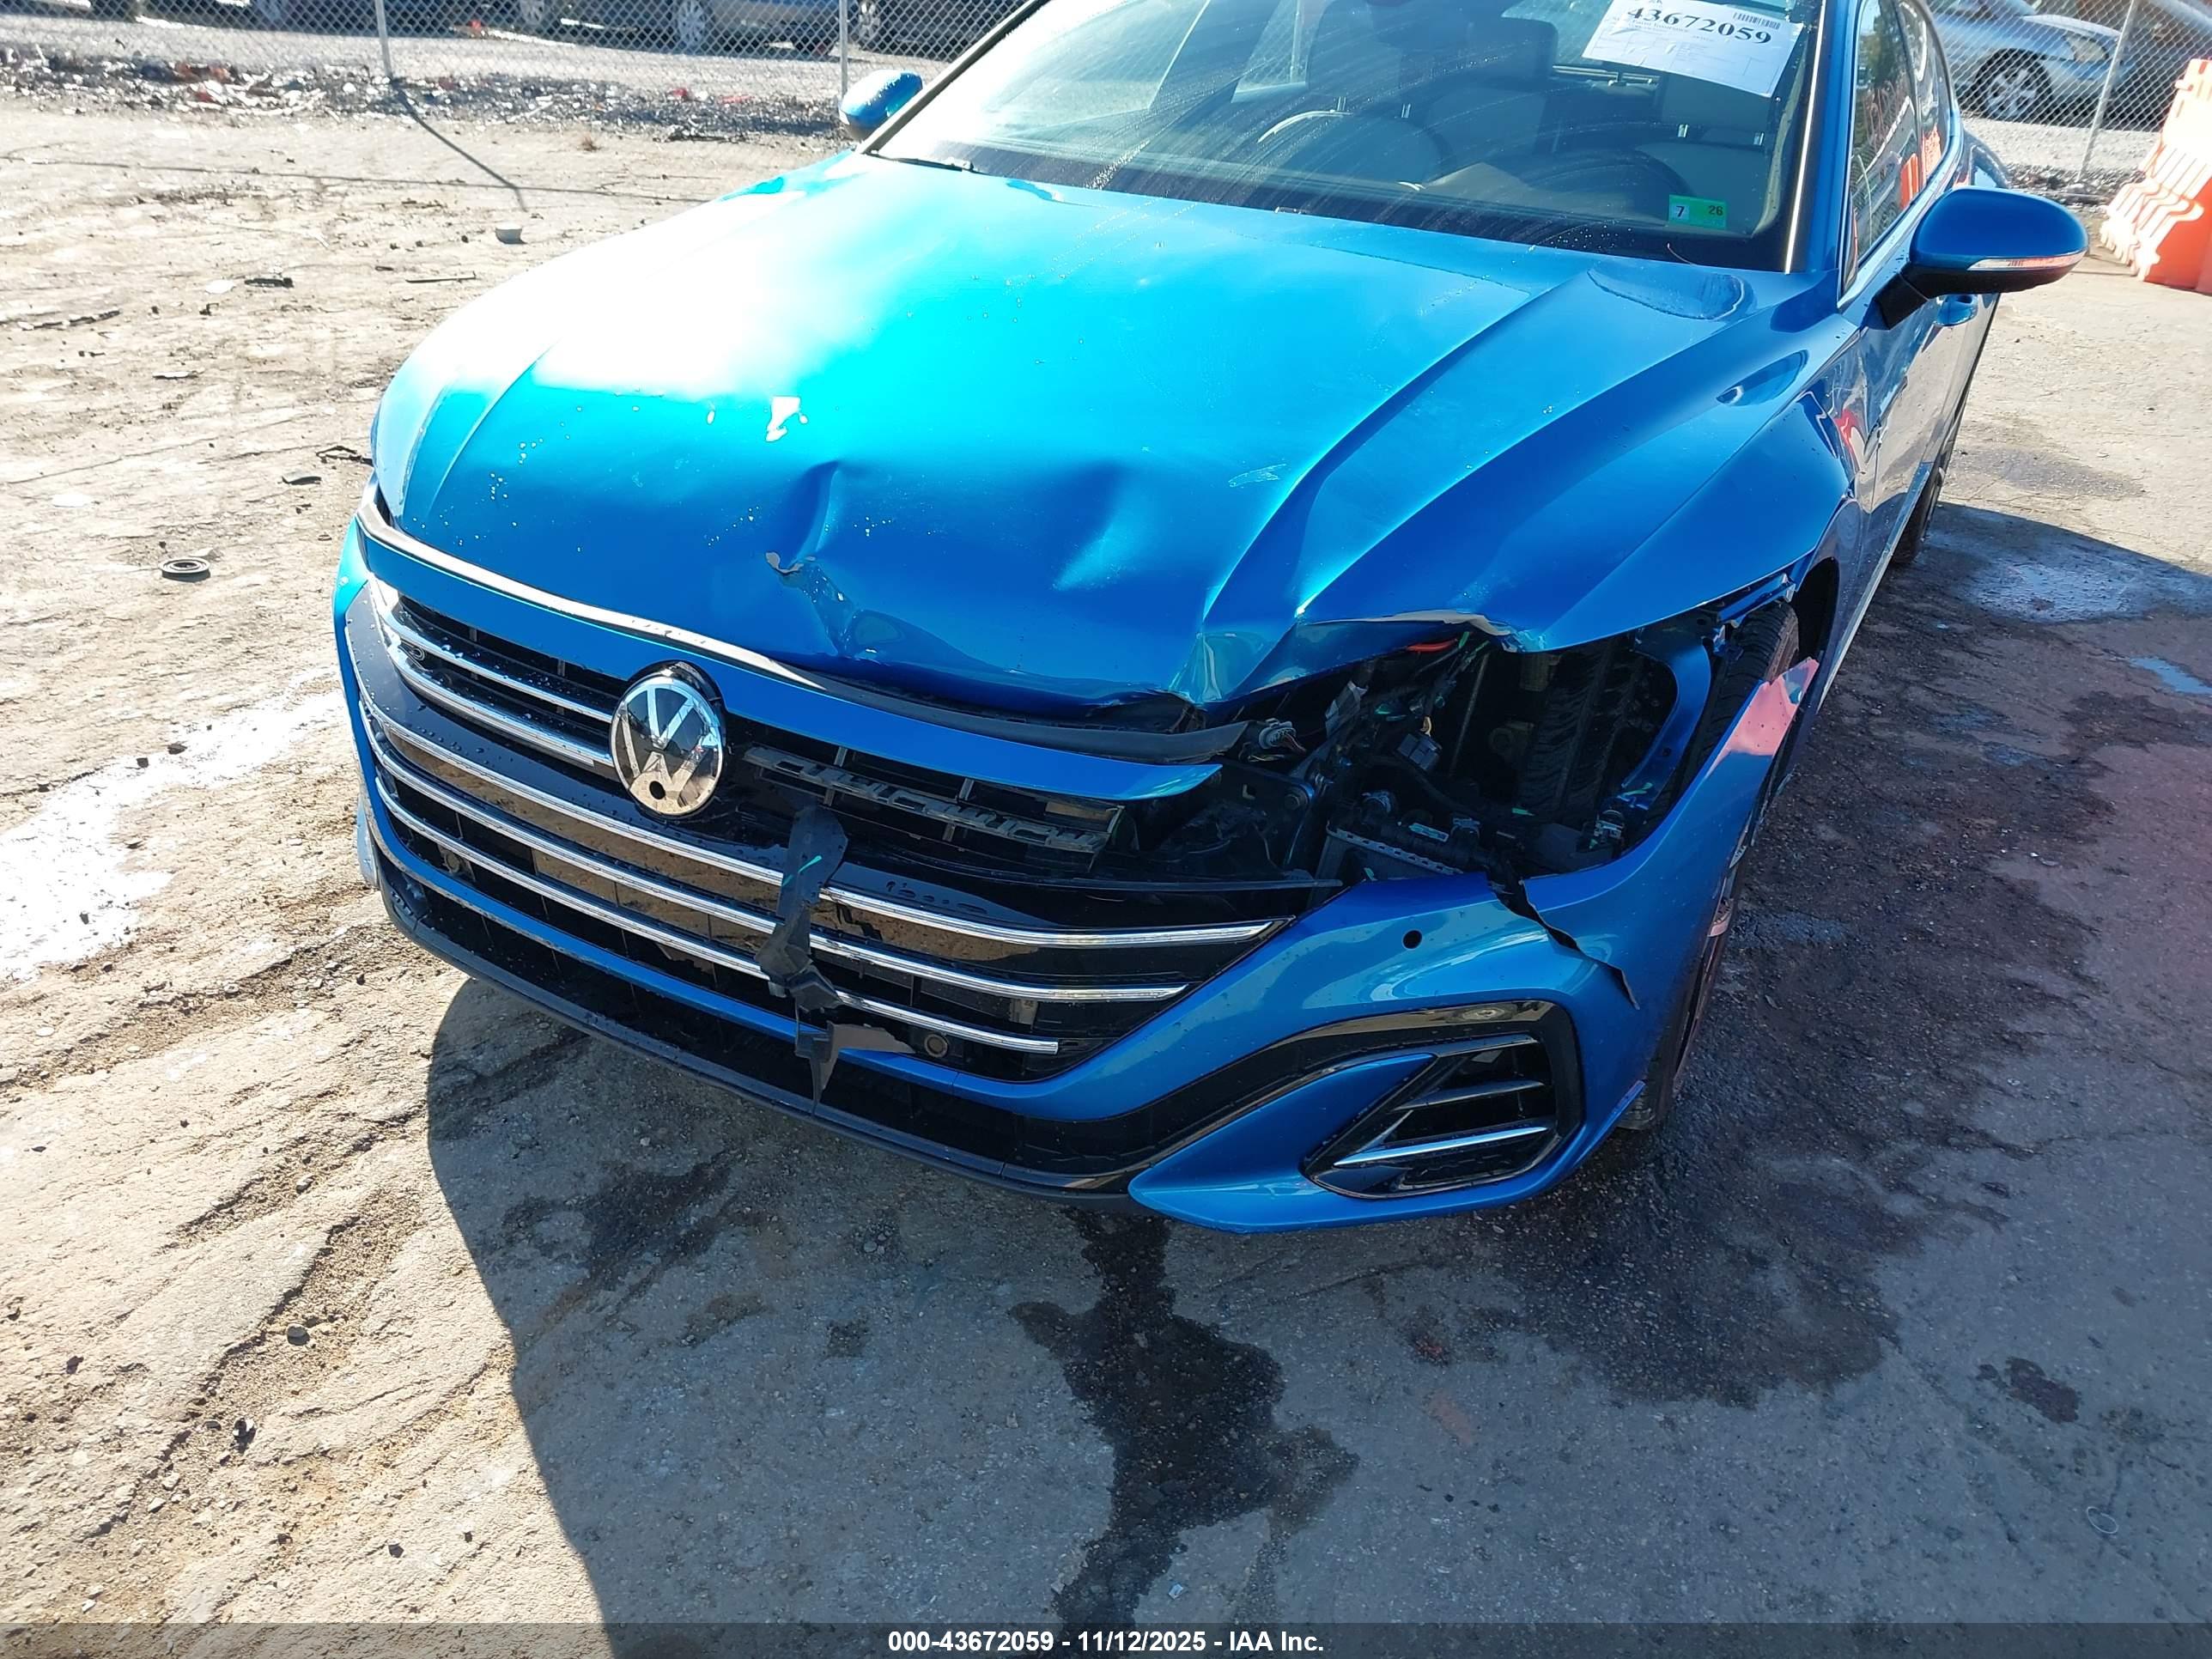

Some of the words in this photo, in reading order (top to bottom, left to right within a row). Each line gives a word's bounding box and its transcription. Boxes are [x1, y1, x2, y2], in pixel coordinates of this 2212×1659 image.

[1627, 7, 1771, 44] 43672059
[1675, 205, 1686, 217] 7
[1708, 204, 1723, 216] 26
